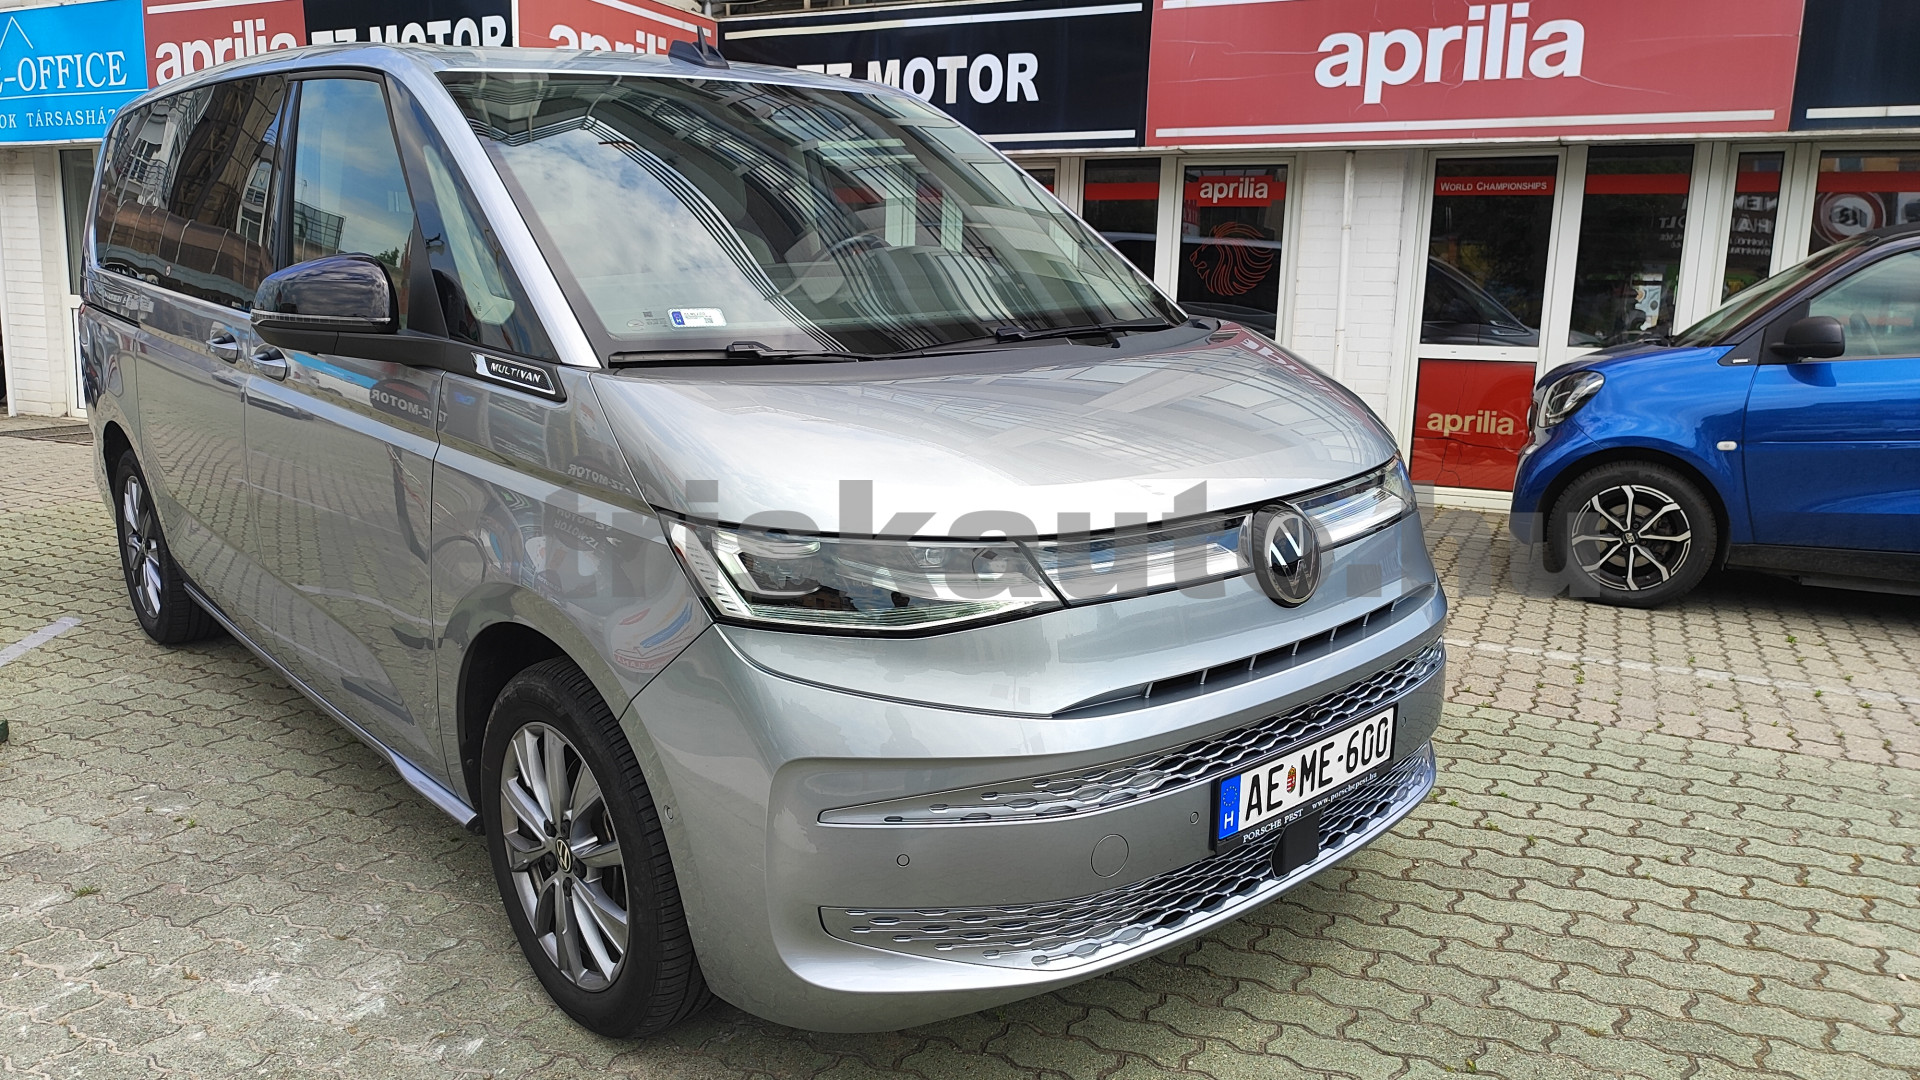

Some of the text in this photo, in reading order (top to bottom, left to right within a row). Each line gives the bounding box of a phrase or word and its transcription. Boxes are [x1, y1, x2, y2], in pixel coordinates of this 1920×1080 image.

[1314, 2, 1585, 104] aprilia
[0, 51, 127, 92] -OFFICE
[1200, 177, 1268, 203] aprilia
[490, 362, 541, 383] MULTIVAN
[1426, 410, 1515, 437] aprilia
[1224, 810, 1234, 830] H
[1243, 819, 1282, 843] PORSCHE
[1284, 808, 1304, 825] PEST
